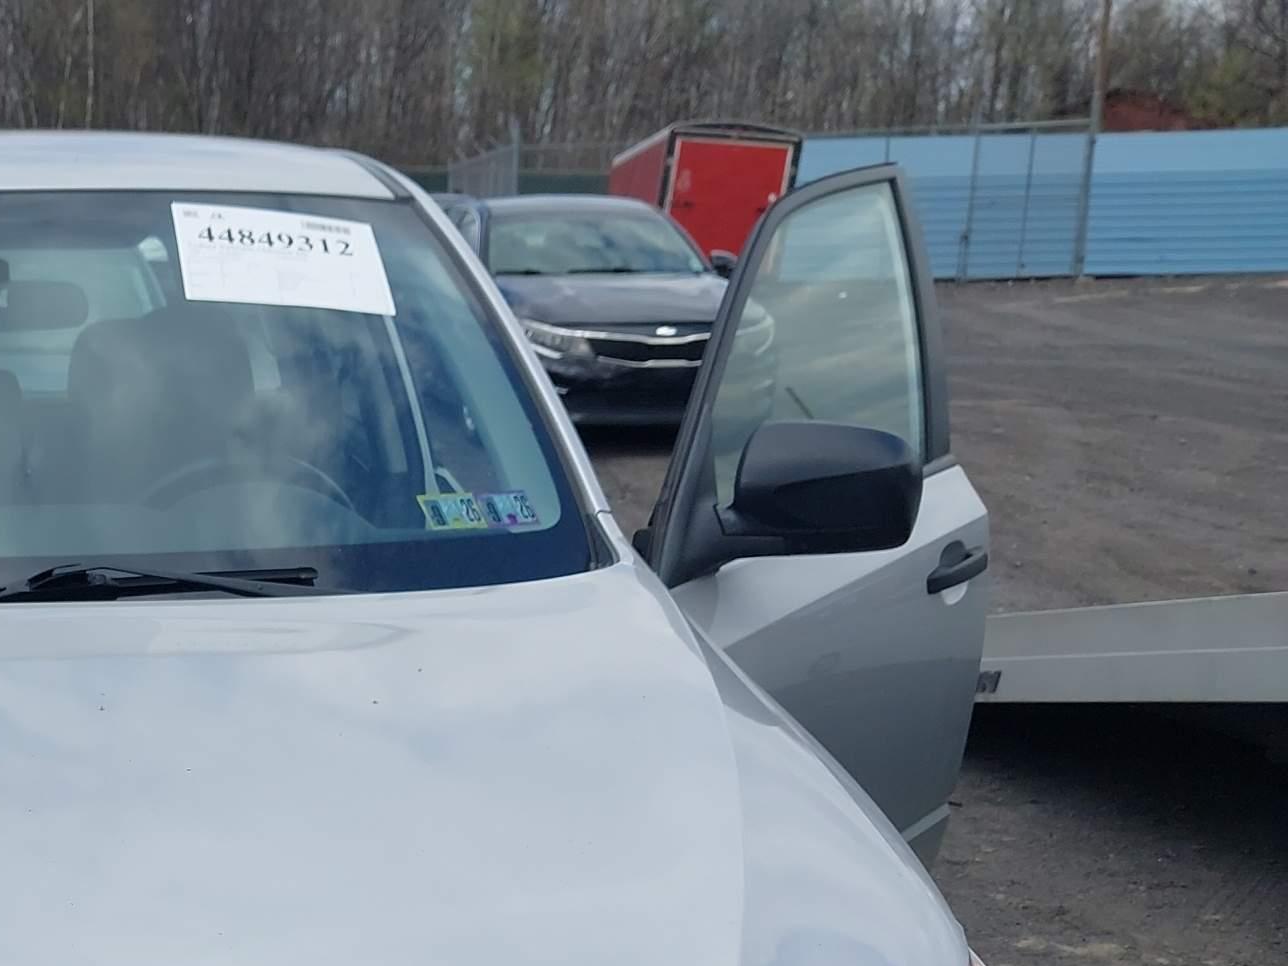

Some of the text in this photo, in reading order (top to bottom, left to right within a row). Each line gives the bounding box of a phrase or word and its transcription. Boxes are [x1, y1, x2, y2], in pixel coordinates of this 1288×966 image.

[198, 225, 354, 257] 44849312
[459, 498, 482, 523] 26
[513, 495, 536, 519] 26
